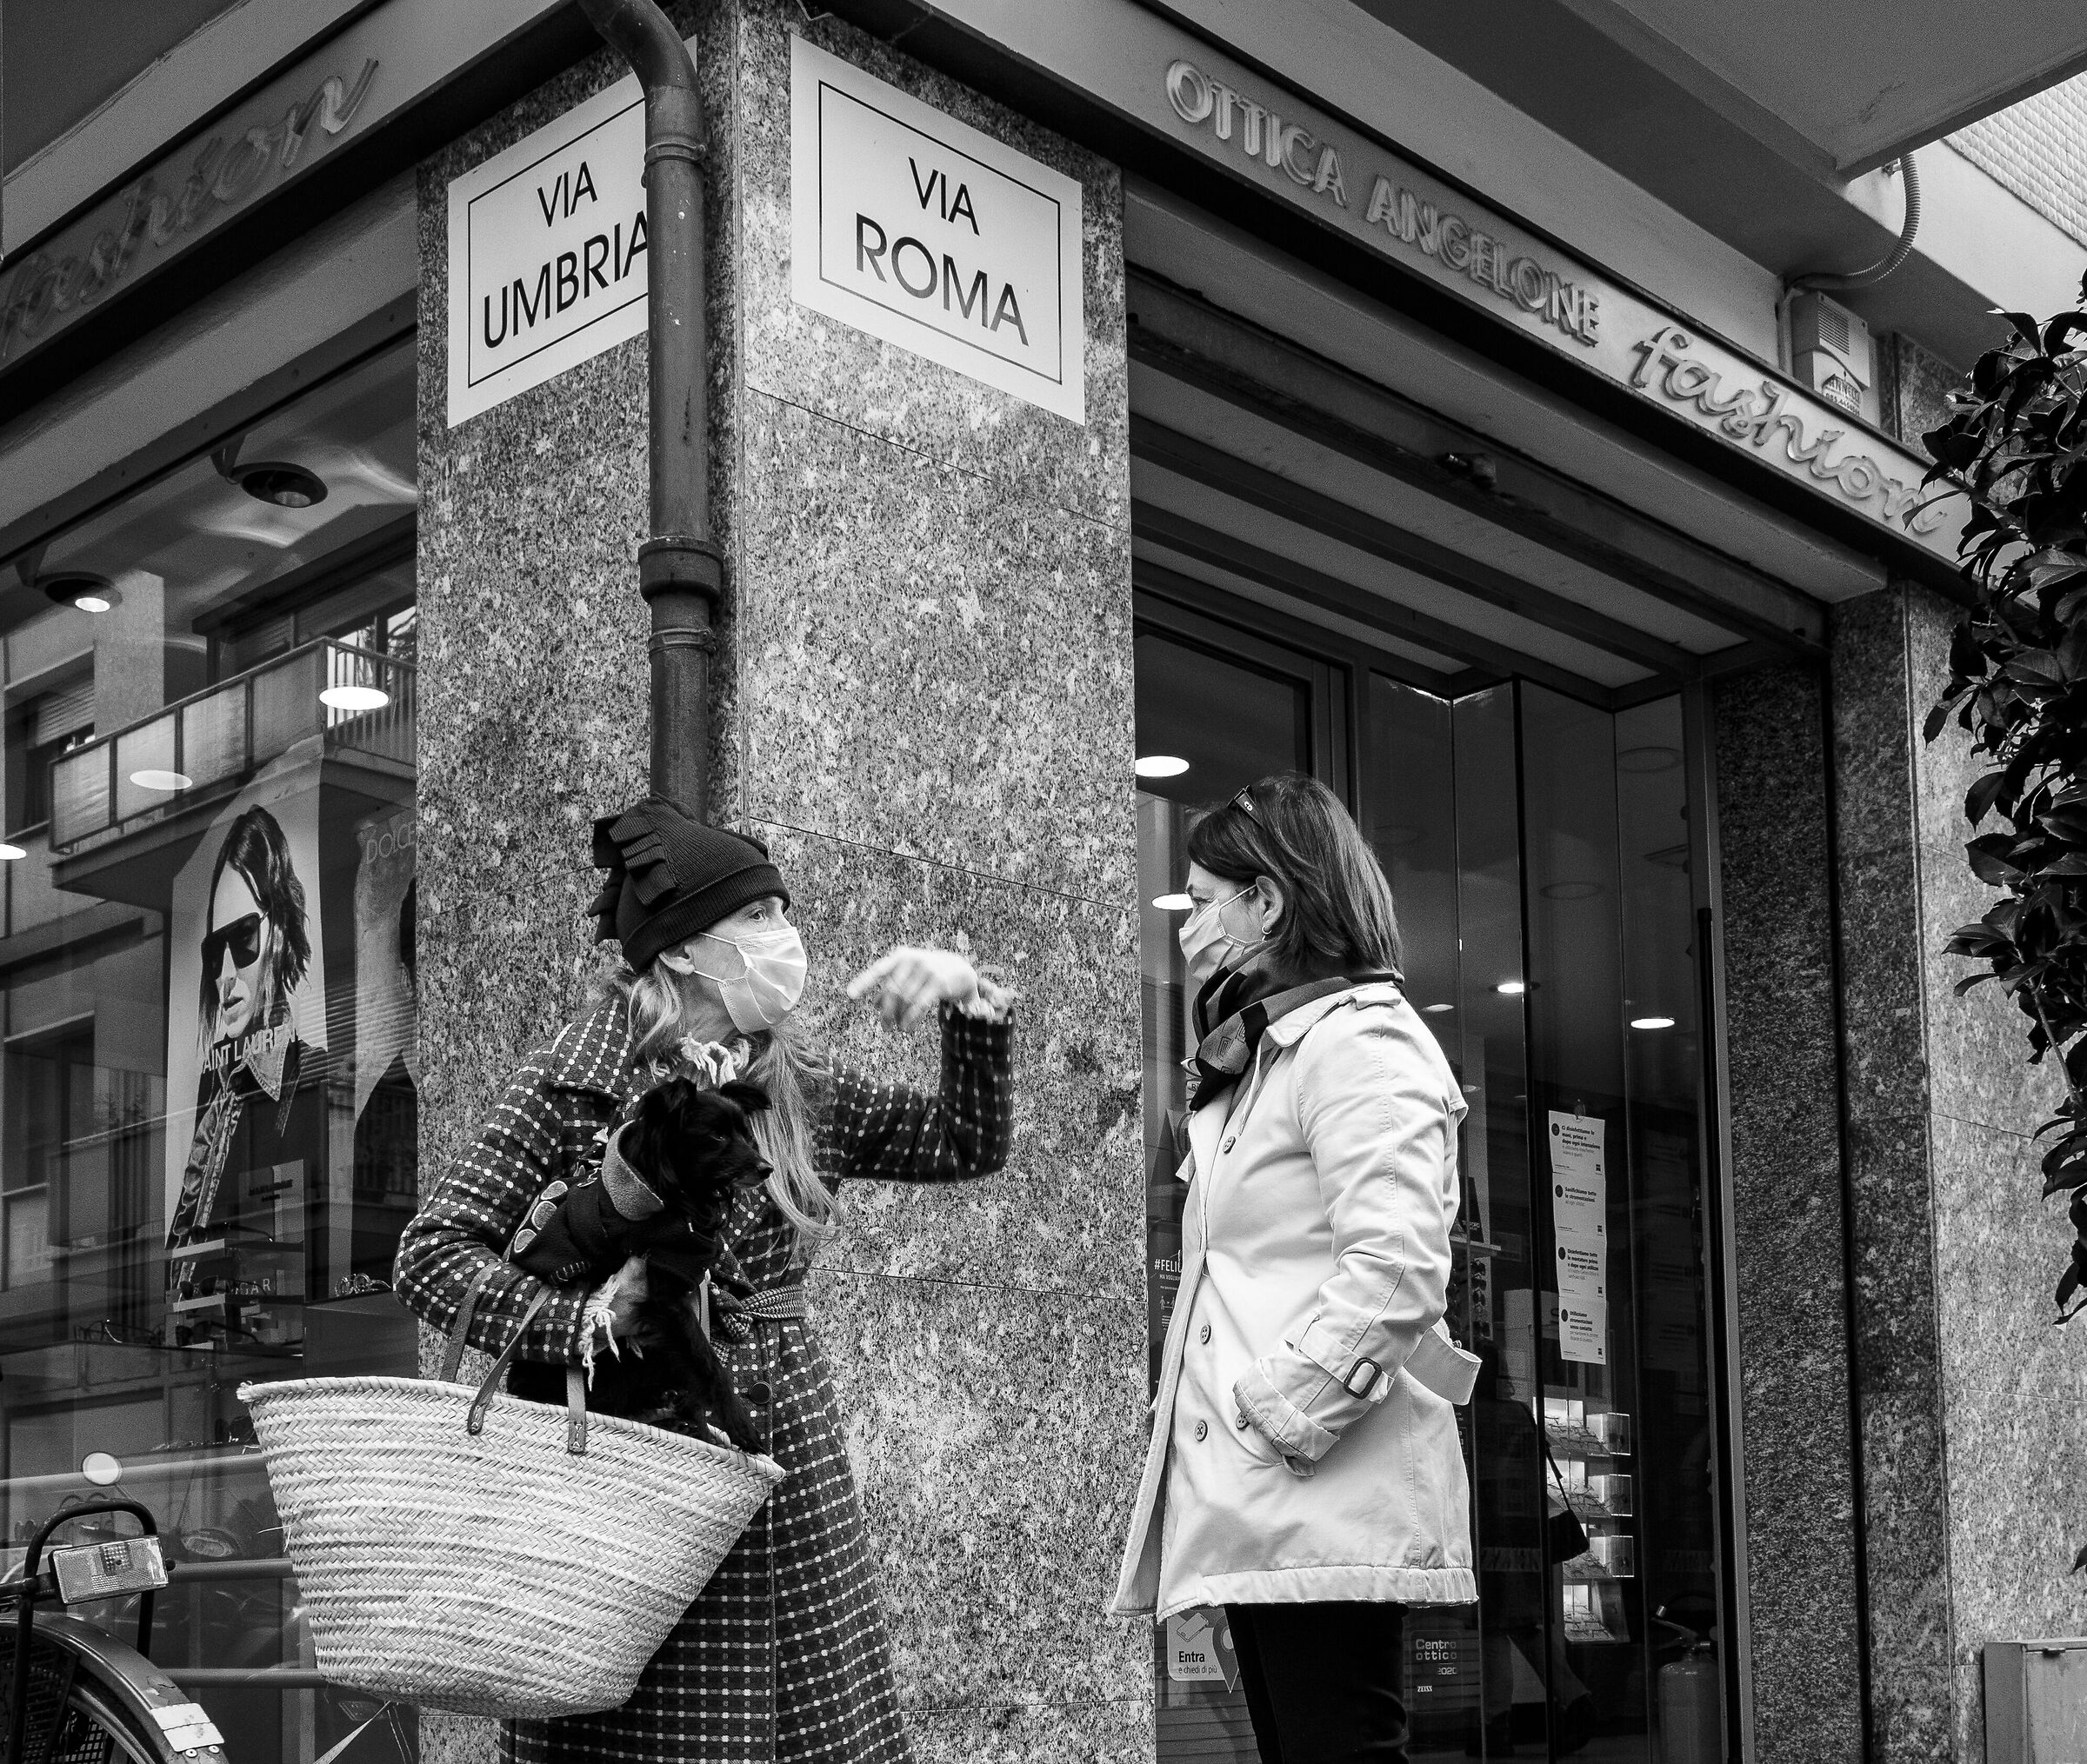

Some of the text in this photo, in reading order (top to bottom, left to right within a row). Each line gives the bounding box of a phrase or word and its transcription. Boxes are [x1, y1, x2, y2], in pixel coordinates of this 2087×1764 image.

[537, 161, 598, 228] VIA
[909, 156, 981, 236] VIA
[484, 210, 648, 349] UMBRIA
[857, 212, 1029, 347] ROMA
[1166, 59, 1948, 533] OTTICA ANGELONE fashion
[203, 1024, 297, 1075] AINT LAUREN
[1178, 1650, 1205, 1663] Entra
[1184, 1665, 1201, 1674] chiedi
[1201, 1665, 1208, 1674] di
[1208, 1664, 1217, 1675] più
[1416, 1639, 1457, 1650] Centro
[1416, 1649, 1457, 1661] ottico
